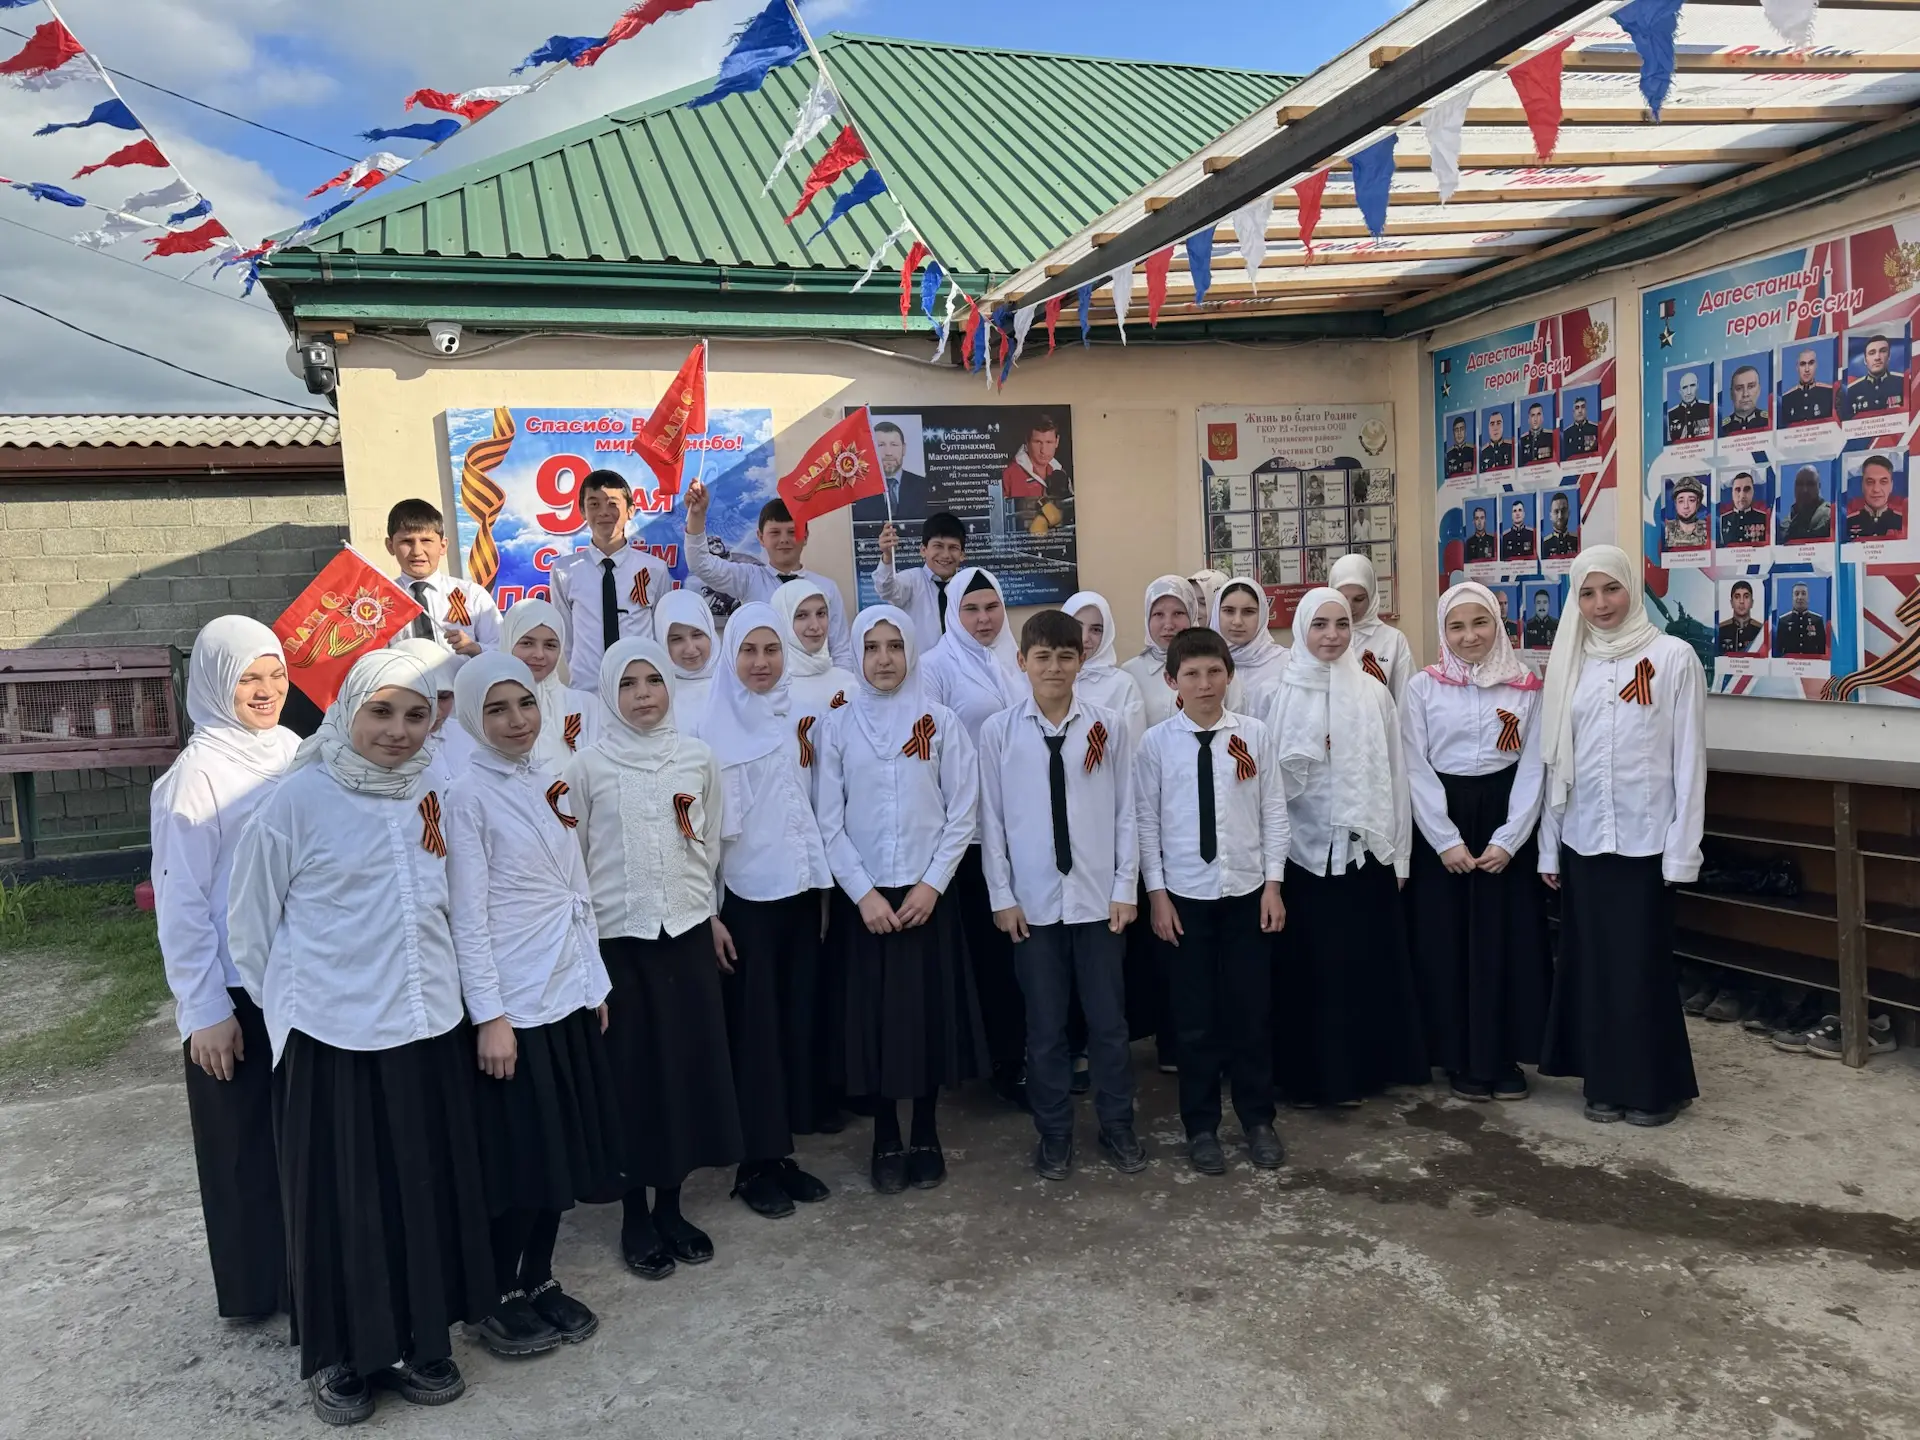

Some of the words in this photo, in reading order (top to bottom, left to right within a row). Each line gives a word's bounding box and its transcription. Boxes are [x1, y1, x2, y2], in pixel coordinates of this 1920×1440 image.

[1698, 266, 1818, 316] Дагестанцы
[1726, 308, 1780, 336] герои
[1786, 288, 1863, 322] России
[1466, 337, 1543, 372] Дагестанцы
[1484, 369, 1520, 391] герои
[1522, 356, 1572, 382] России
[525, 416, 624, 433] Спасибо
[1244, 412, 1278, 423] Жизнь
[1294, 411, 1321, 422] благо
[1324, 411, 1357, 420] Родине
[685, 436, 743, 450] небо!
[944, 432, 990, 441] Ибрагимов
[940, 443, 996, 452] Султанахмед
[1272, 447, 1313, 455] Участники
[1315, 446, 1334, 454] СВО
[928, 452, 1008, 460] Магомедсалихович
[536, 454, 594, 535] 9
[632, 488, 672, 512] АЯ
